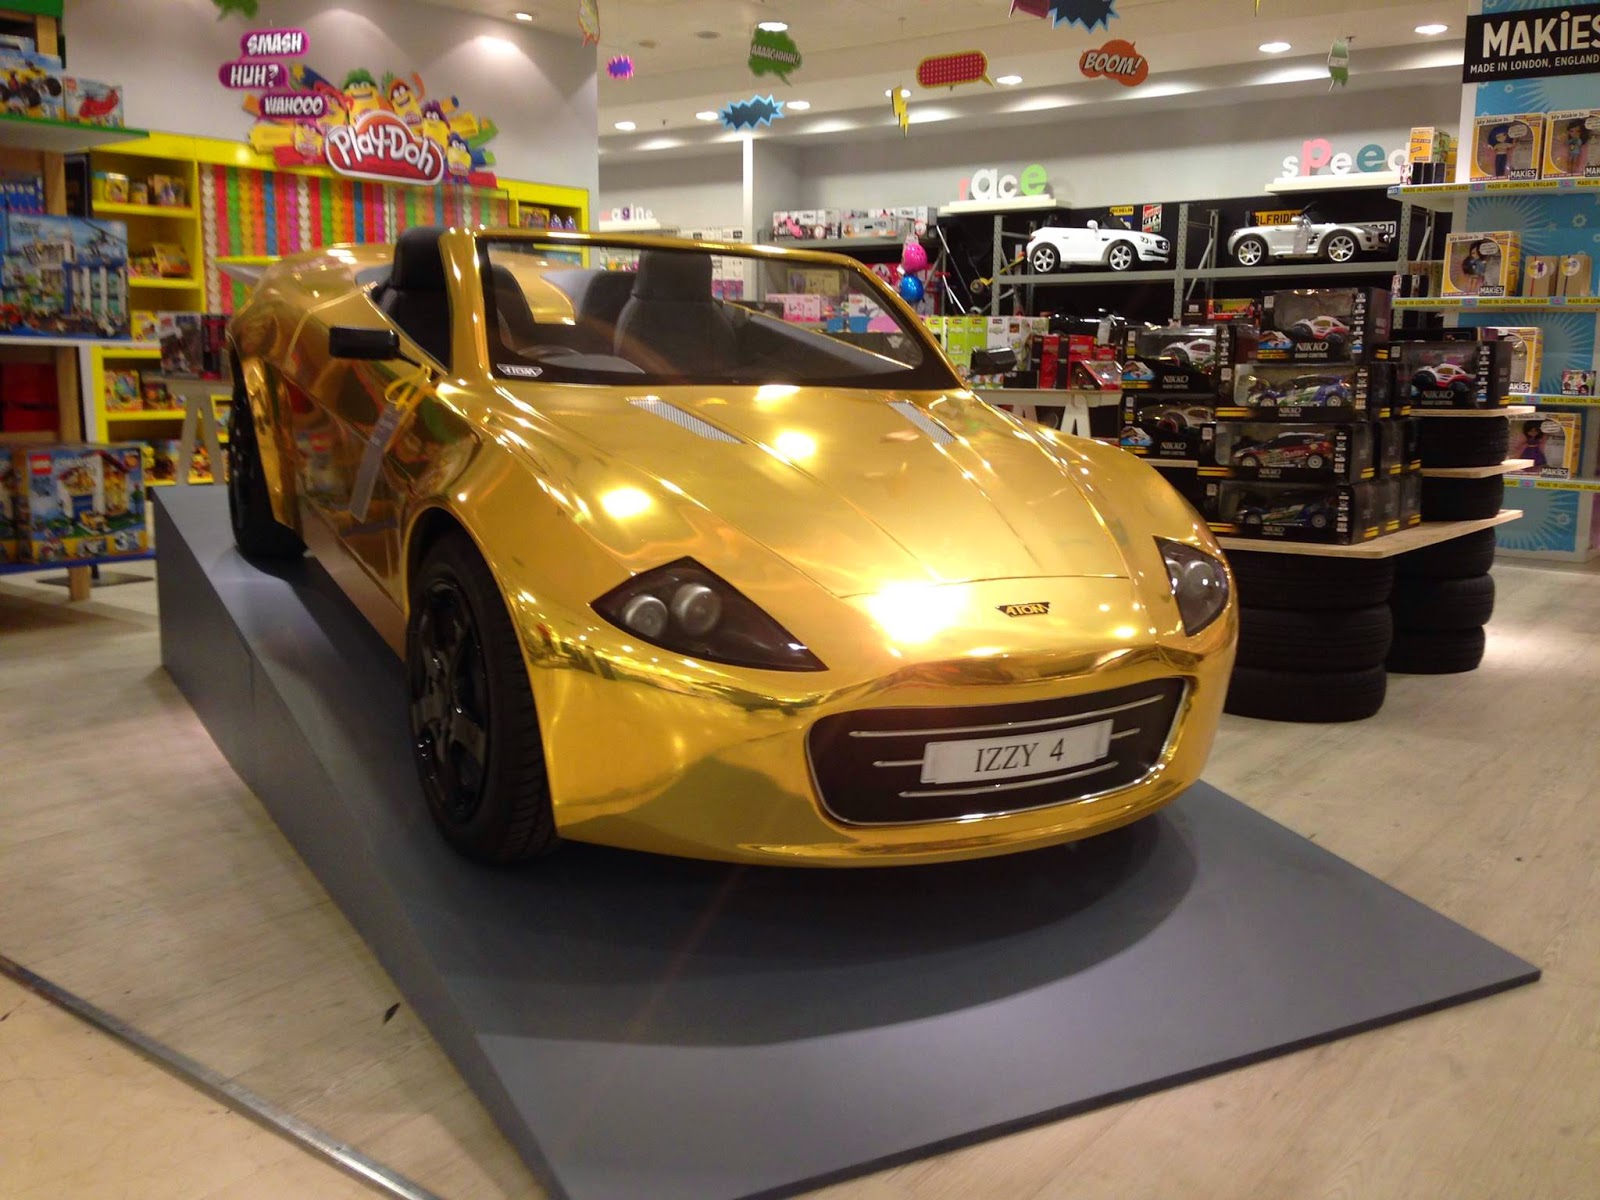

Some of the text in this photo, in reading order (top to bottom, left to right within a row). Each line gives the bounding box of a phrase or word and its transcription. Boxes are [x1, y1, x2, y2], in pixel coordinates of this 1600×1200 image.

[247, 32, 303, 56] SMASH
[1084, 52, 1143, 75] BOOM!
[1470, 54, 1600, 74] MADE IN LONDON, ENGLAND
[230, 64, 279, 88] HUH?
[264, 95, 323, 116] WAHOOO
[328, 124, 434, 176] Play-Doh
[1282, 138, 1411, 178] speed
[1585, 166, 1600, 174] MAK
[959, 164, 1047, 200] race
[1295, 341, 1329, 351] NIKKO
[1163, 375, 1189, 383] NIKKO
[1509, 382, 1530, 391] AKiES
[1422, 390, 1455, 399] NIKKO
[974, 738, 1064, 772] IZZY 4
